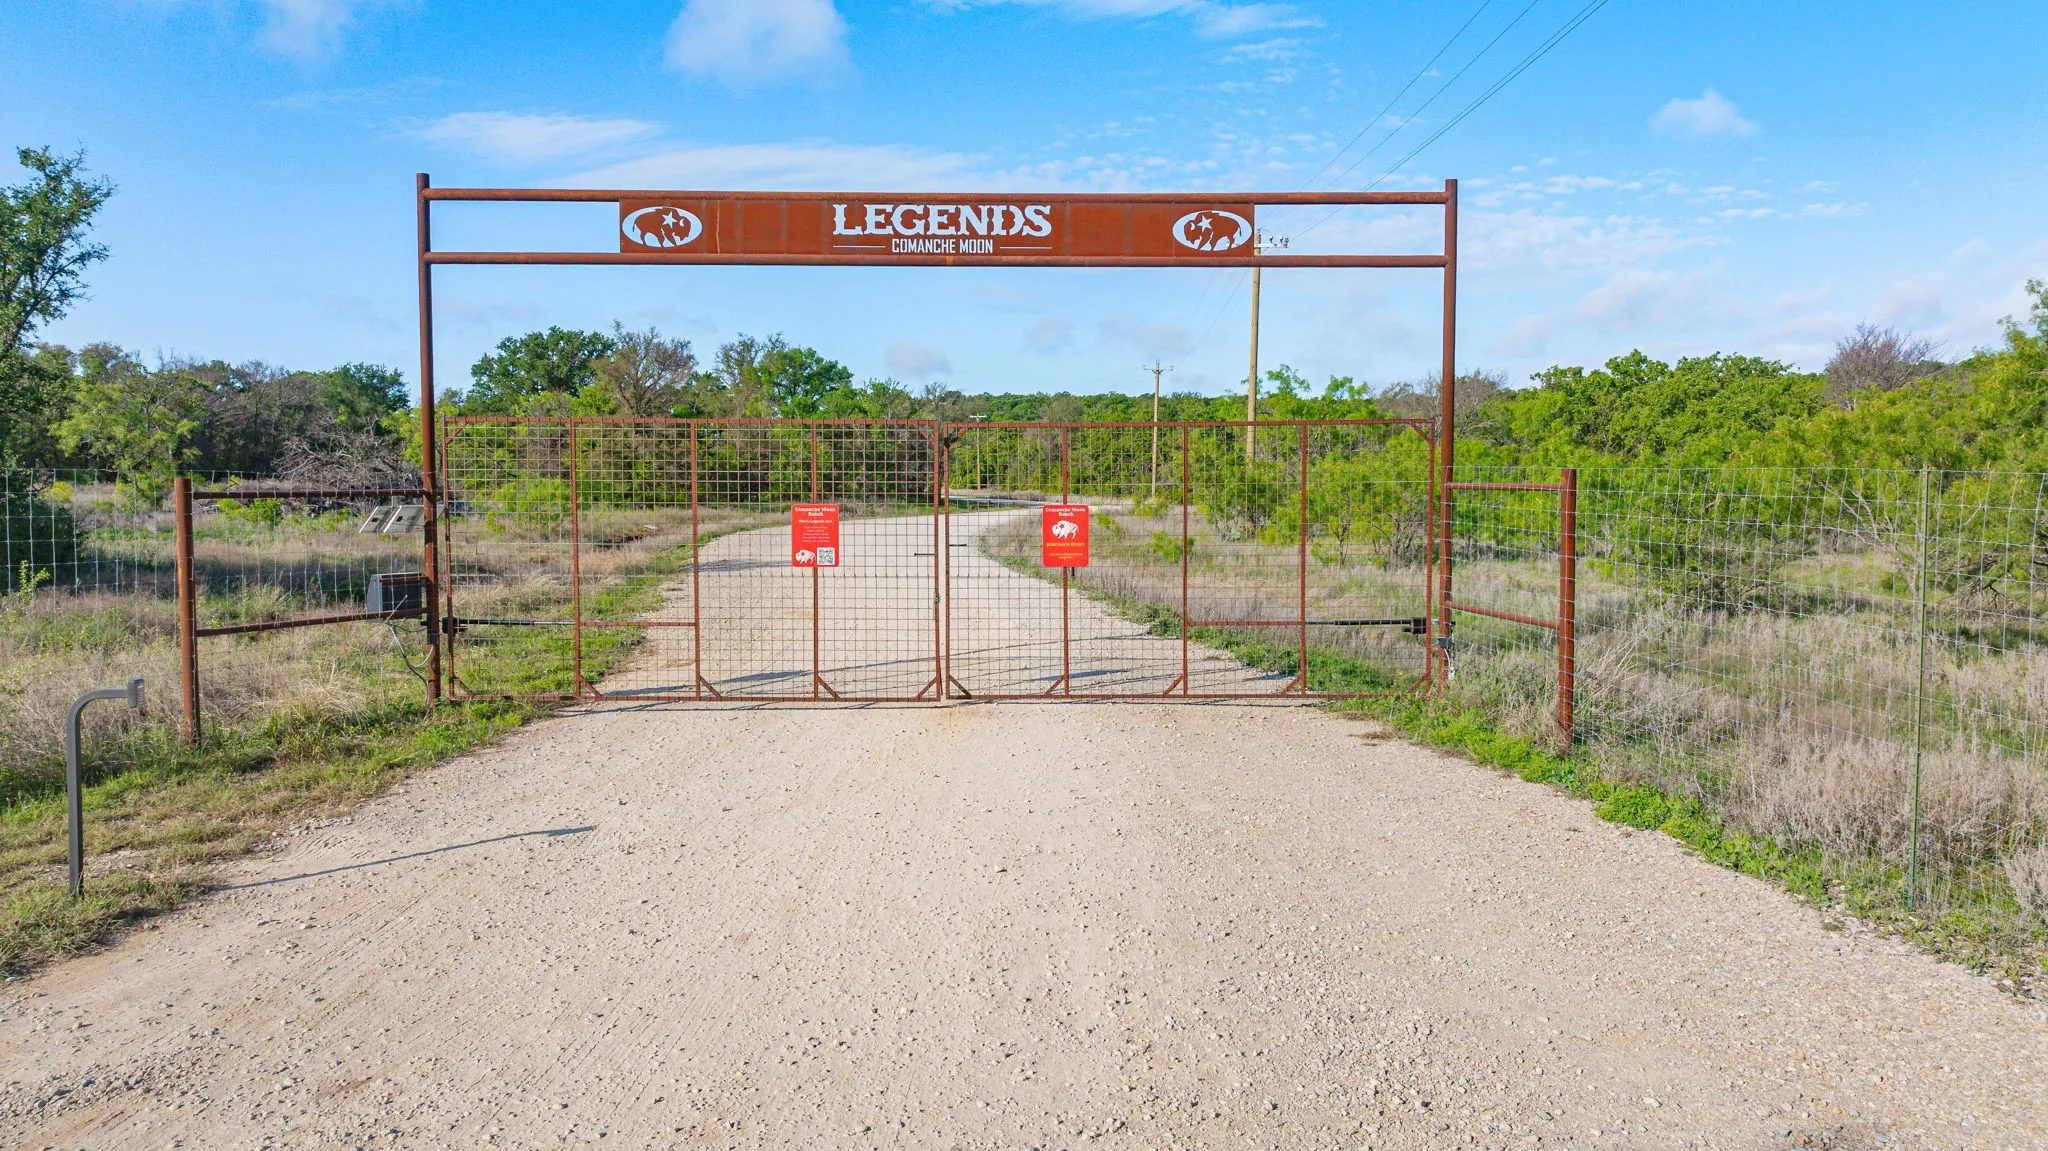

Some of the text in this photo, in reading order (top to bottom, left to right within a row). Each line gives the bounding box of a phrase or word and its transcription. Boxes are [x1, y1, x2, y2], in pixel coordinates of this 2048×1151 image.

[832, 203, 1053, 237] LEGENDS
[891, 238, 994, 254] COMANCHE MOON
